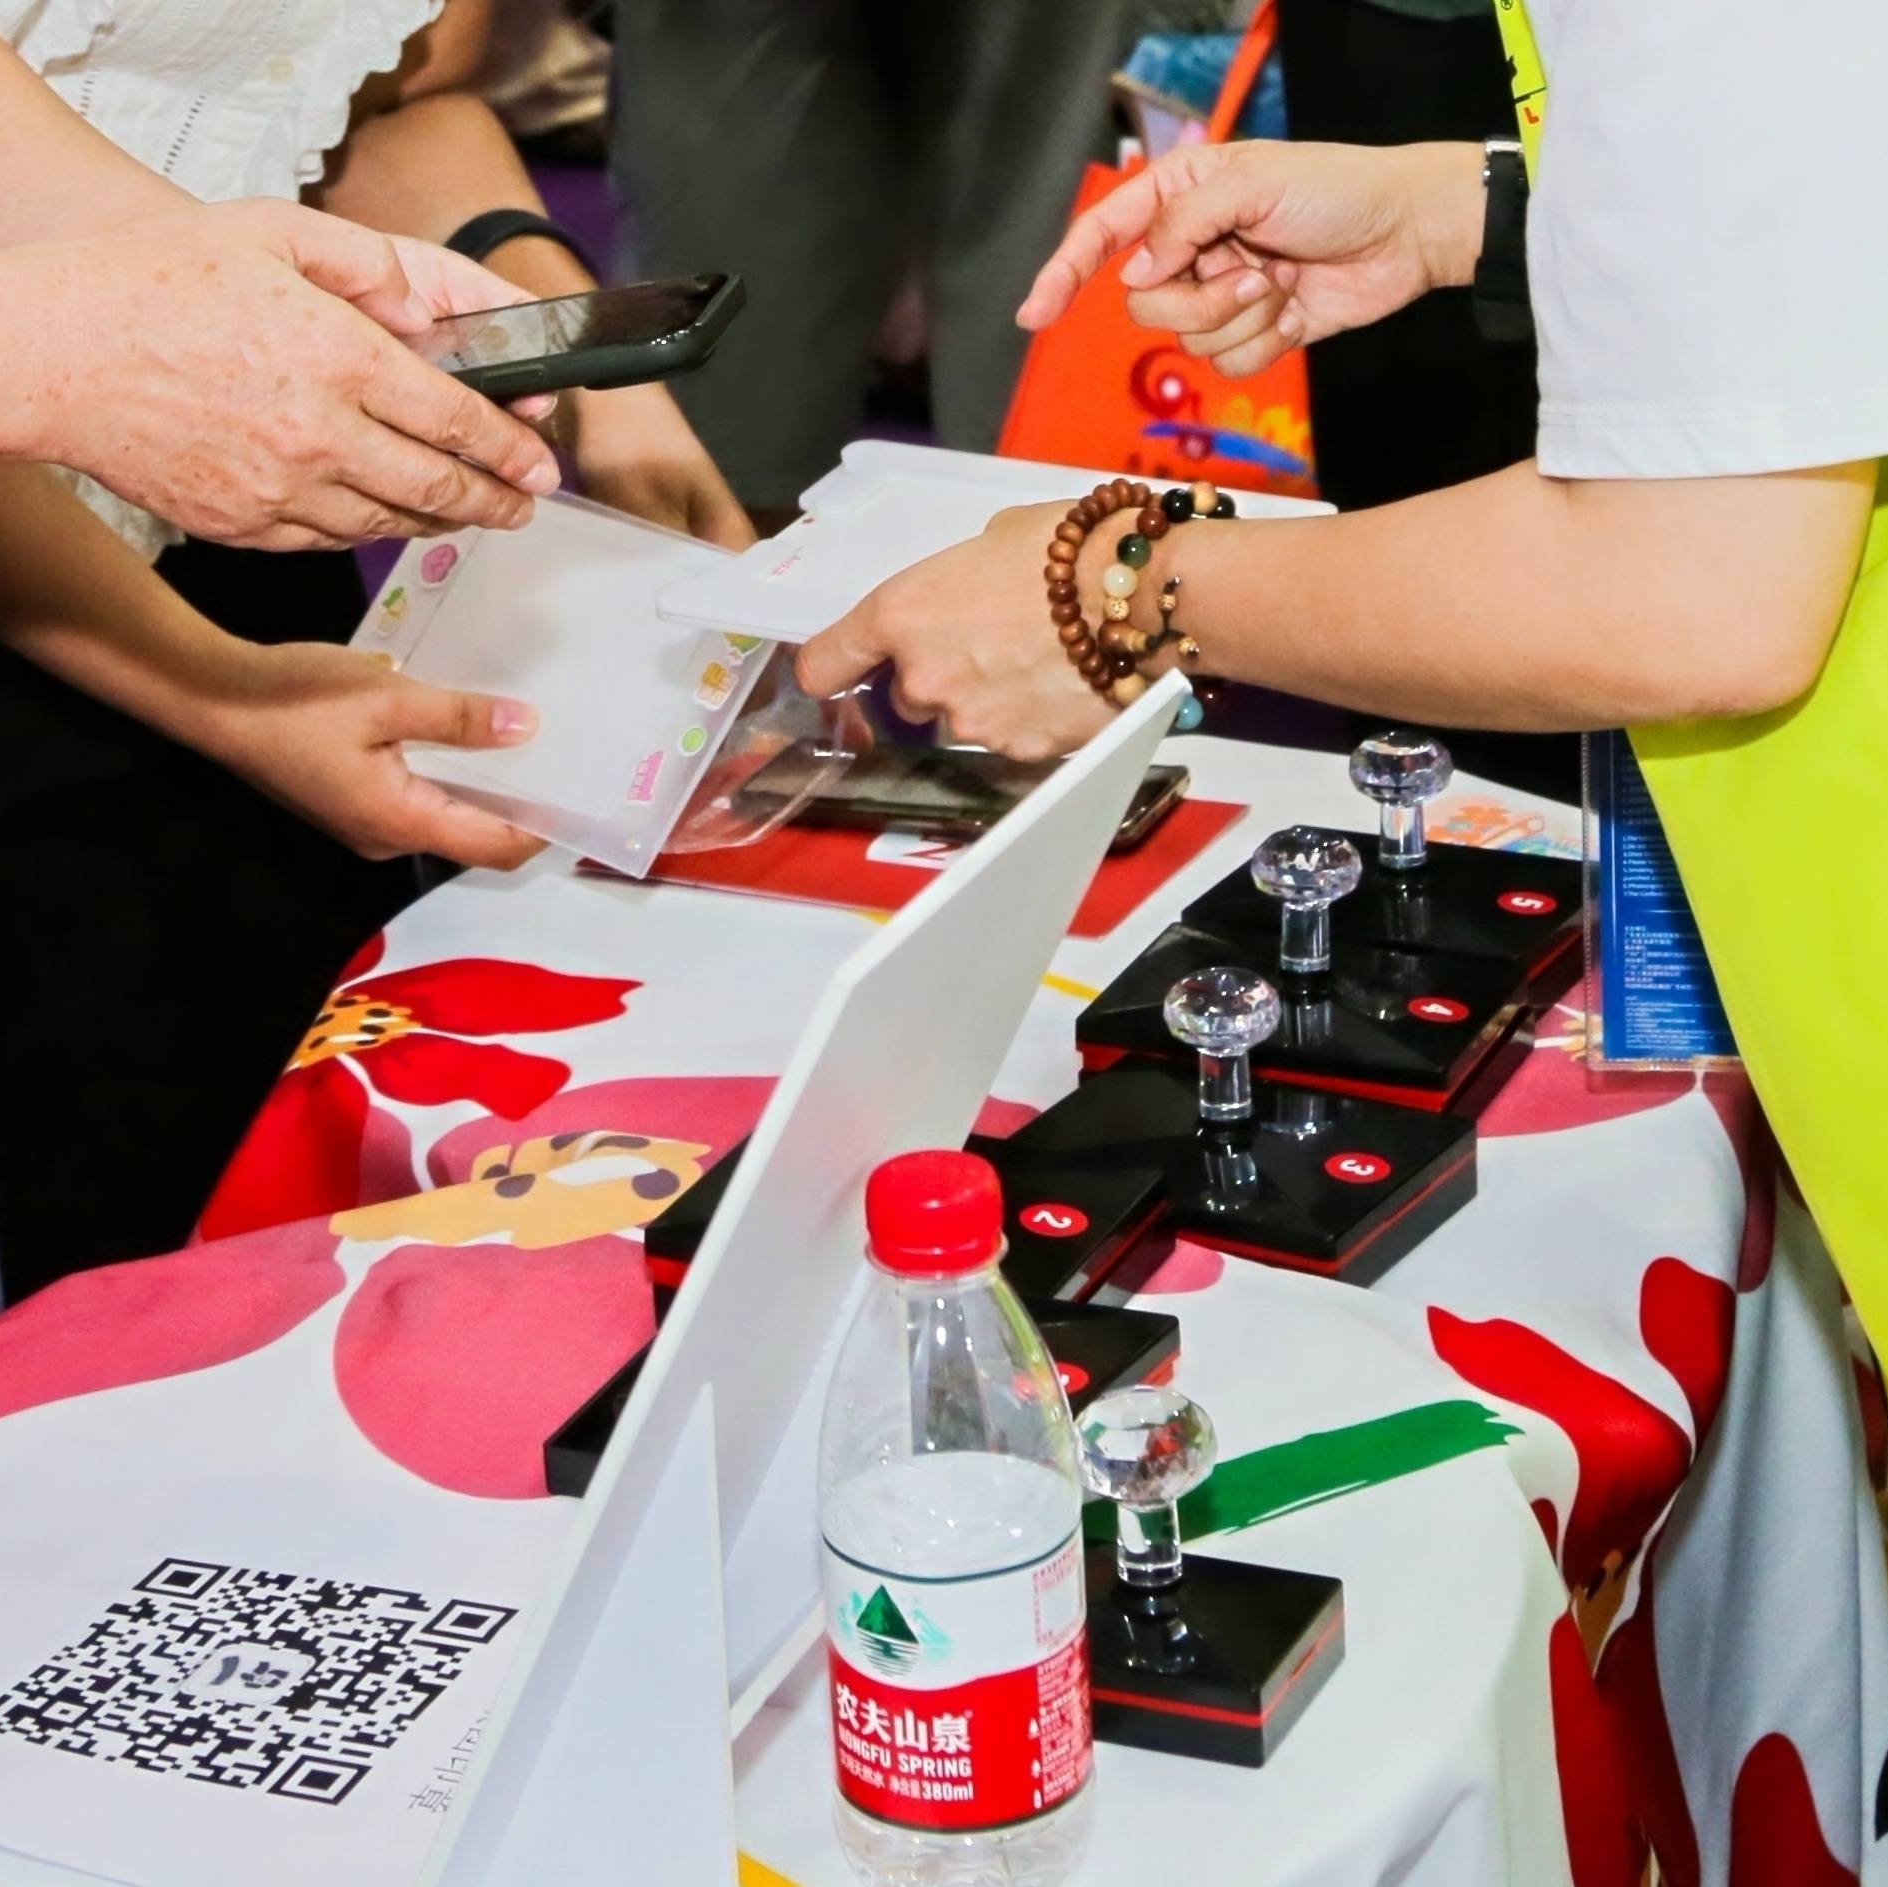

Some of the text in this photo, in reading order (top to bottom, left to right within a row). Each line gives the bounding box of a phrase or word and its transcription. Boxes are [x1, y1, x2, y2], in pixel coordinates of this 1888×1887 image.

[835, 1681, 974, 1754] 农夫山泉
[897, 1752, 973, 1779] SPRING
